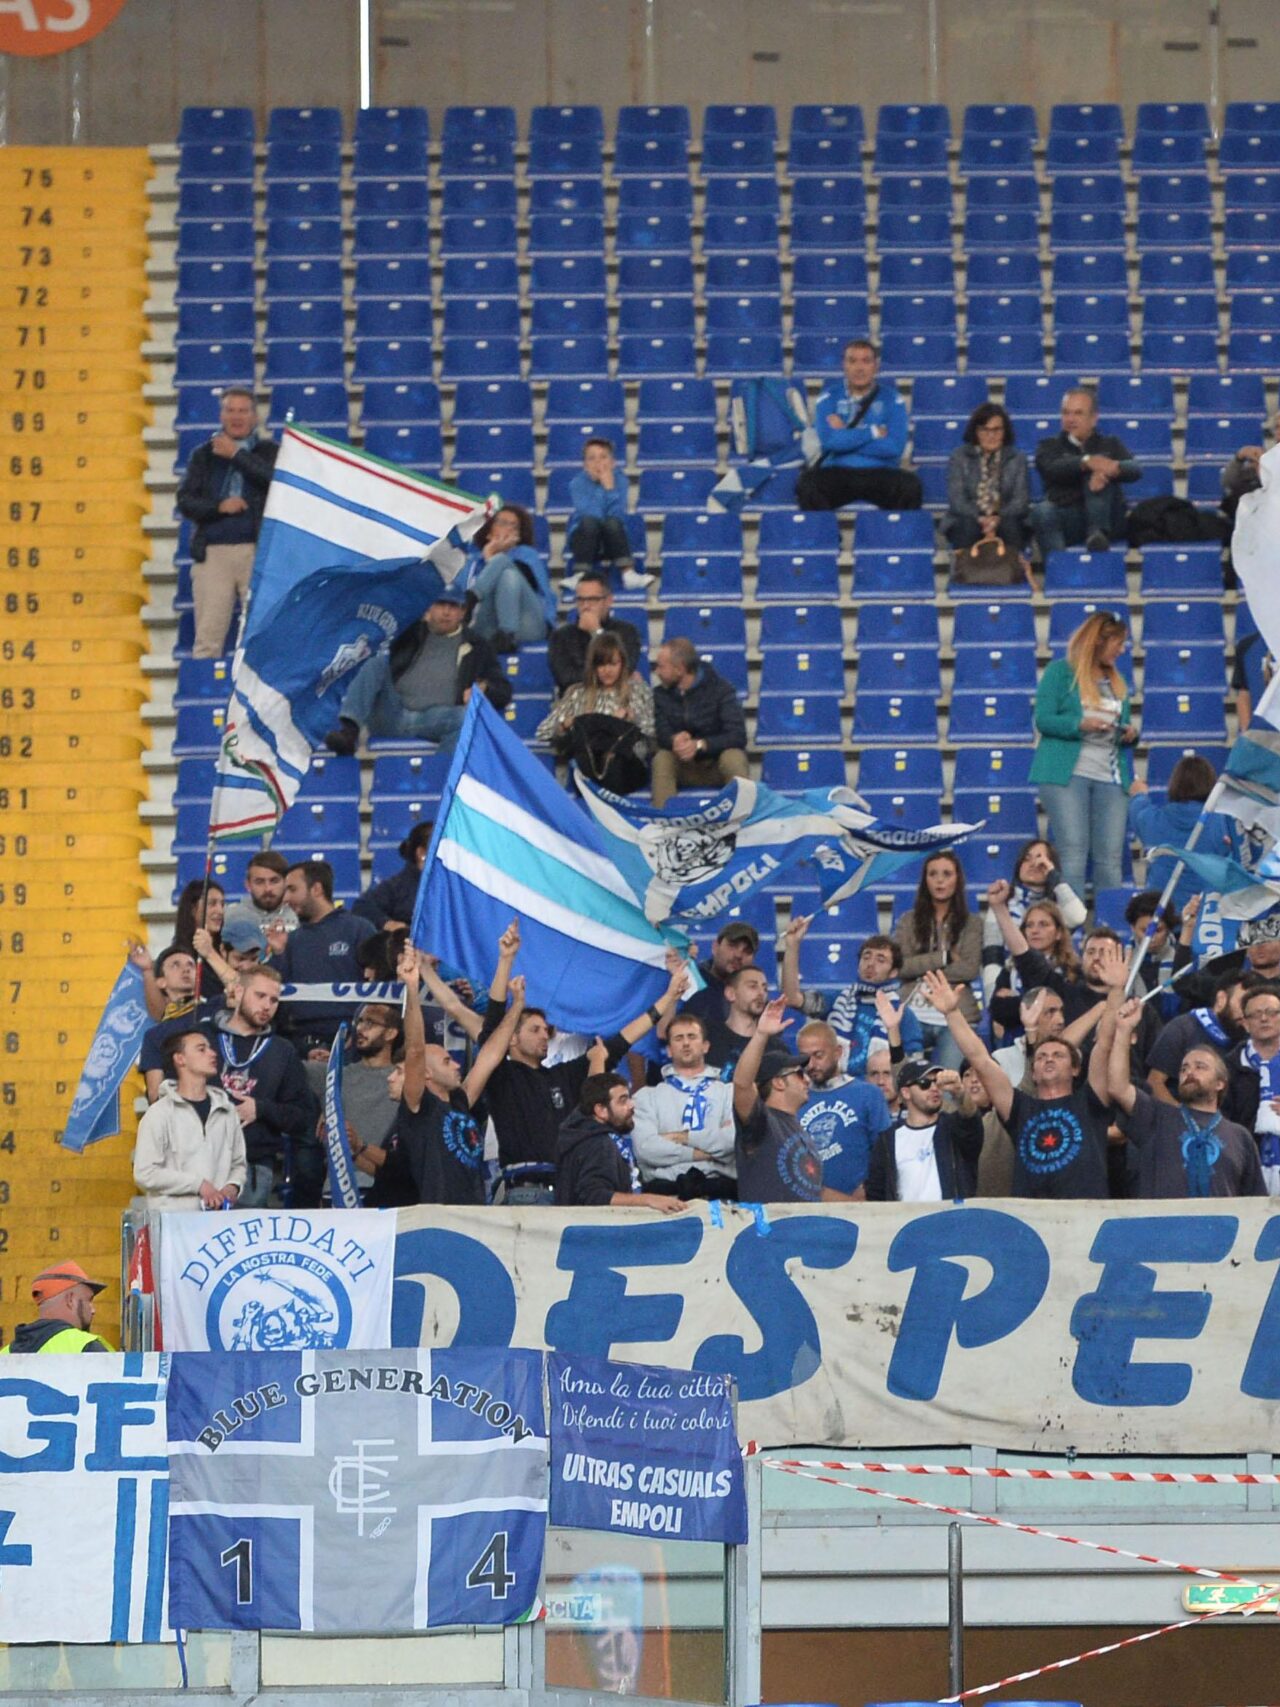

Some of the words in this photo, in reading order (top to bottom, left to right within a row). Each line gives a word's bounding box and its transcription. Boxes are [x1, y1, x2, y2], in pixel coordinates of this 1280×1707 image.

[21, 167, 54, 189] 75
[21, 205, 54, 228] 74
[18, 245, 53, 268] 73
[15, 285, 49, 309] 72
[16, 325, 47, 348] 71
[13, 367, 47, 391] 70
[11, 410, 45, 434] 69
[9, 455, 44, 478] 68
[8, 500, 43, 524] 67
[6, 545, 41, 570] 66
[4, 591, 40, 615] 65
[1, 638, 37, 663] 64
[0, 686, 36, 711] 63
[0, 734, 33, 760] 62
[0, 930, 25, 955] 8
[180, 1215, 375, 1292] DIFFIDATI
[222, 1270, 239, 1287] LA
[240, 1251, 296, 1273] NOSTRA
[299, 1256, 334, 1284] FEDE
[559, 1366, 605, 1395] Ama
[610, 1371, 633, 1398] la
[636, 1376, 673, 1400] tua
[196, 1383, 287, 1453] BLUE
[295, 1366, 534, 1445] GENERATION
[562, 1401, 625, 1434] Difendi
[629, 1411, 638, 1430] i
[643, 1411, 679, 1431] tuoi
[681, 1408, 732, 1432] colori
[562, 1453, 636, 1491] ULTRAS
[638, 1466, 733, 1499] CASUALS
[610, 1499, 683, 1534] EMPOLI
[220, 1537, 253, 1606] 1
[465, 1530, 516, 1600] 4
